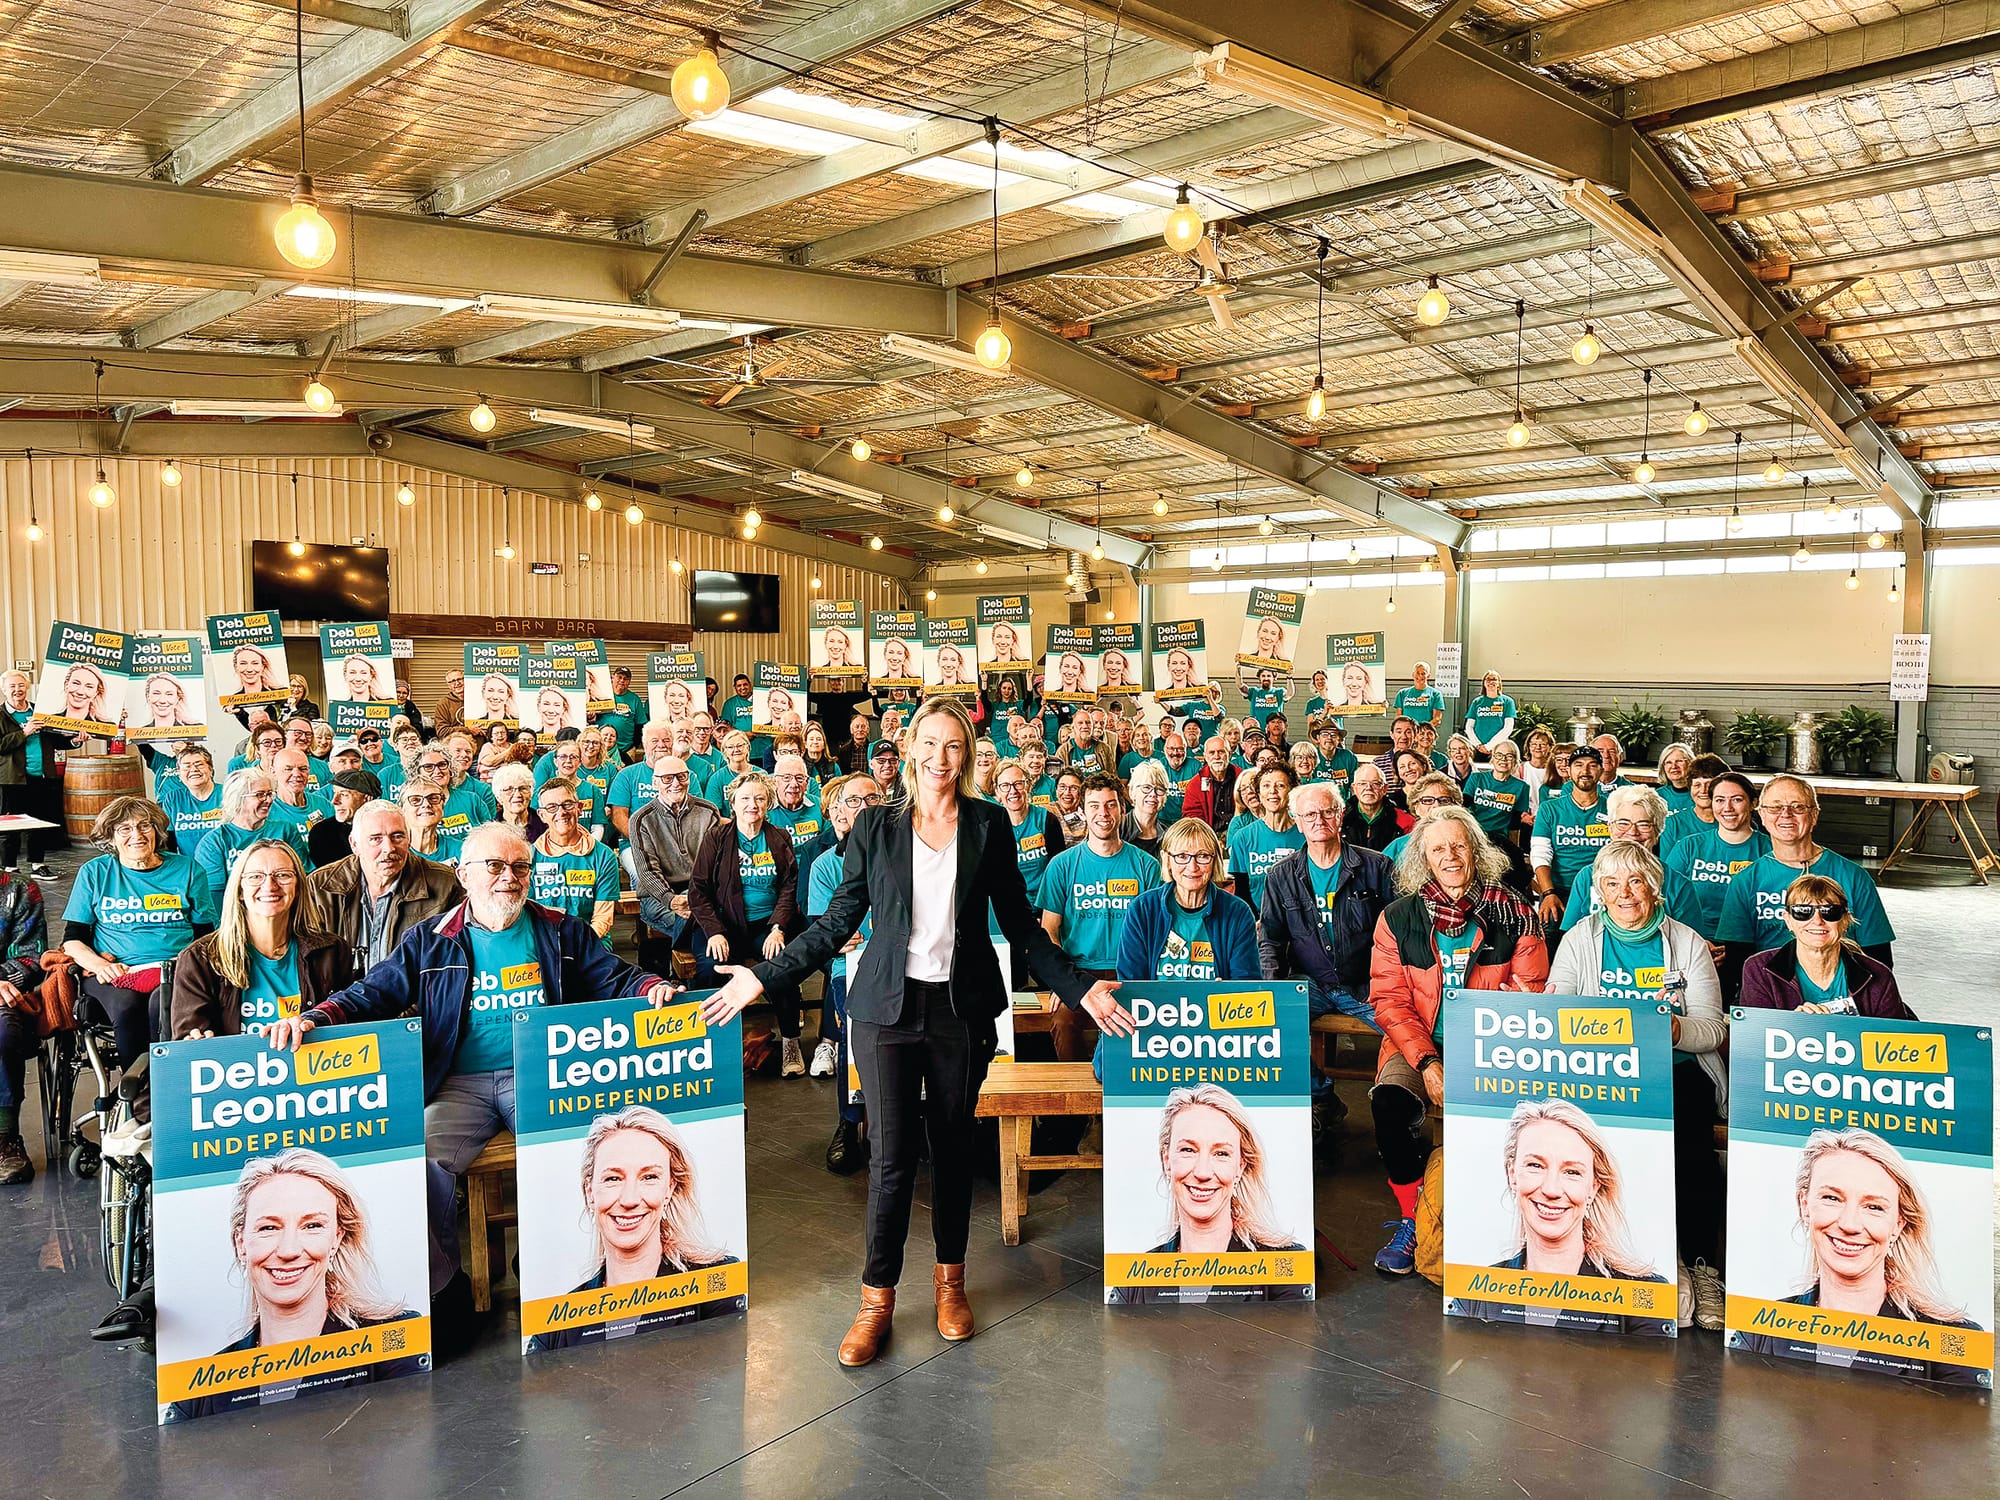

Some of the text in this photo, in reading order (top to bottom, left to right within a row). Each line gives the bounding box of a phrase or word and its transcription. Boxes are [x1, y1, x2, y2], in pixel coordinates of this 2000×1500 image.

[1257, 590, 1277, 601] Deb
[816, 603, 836, 612] Deb
[983, 600, 1003, 609] Deb
[983, 606, 1023, 616] Leonard
[1255, 599, 1296, 613] Leonard
[816, 611, 856, 620] Leonard
[876, 614, 896, 623] Deb
[216, 618, 244, 630] Deb
[495, 620, 596, 634] BARN BARR
[876, 622, 916, 631] Leonard
[928, 621, 948, 631] Deb
[1100, 627, 1115, 635] eb
[1158, 626, 1178, 635] Deb
[62, 627, 94, 643] Deb
[218, 625, 273, 639] Leonard
[328, 627, 355, 638] Deb
[929, 629, 968, 638] Leonard
[1054, 627, 1074, 637] Deb
[1100, 634, 1134, 643] eonard
[1158, 632, 1198, 643] Leonard
[219, 636, 274, 646] INDEPENDENT
[329, 635, 382, 648] Leonard
[552, 643, 575, 652] Deb
[1053, 636, 1093, 646] Leonard
[1334, 638, 1354, 646] Deb
[59, 638, 123, 660] Leonard
[331, 647, 383, 655] INDEPENDENT
[472, 647, 496, 657] Deb
[1334, 645, 1376, 655] Leonard
[57, 651, 121, 668] INDEPENDENT
[528, 659, 552, 668] Deb
[654, 656, 675, 665] Deb
[528, 669, 577, 679] Leonard
[654, 664, 697, 673] Leonard
[761, 665, 780, 674] Deb
[761, 672, 800, 682] Leonard
[338, 706, 364, 716] Deb
[176, 811, 202, 822] Deb
[1556, 825, 1584, 837] Deb
[1694, 859, 1727, 873] Deb
[569, 872, 585, 882] Vote
[1692, 870, 1732, 884] Leon
[1074, 884, 1106, 897] Deb
[1111, 884, 1129, 893] Vote
[101, 896, 143, 912] Deb
[150, 896, 171, 908] Vote
[1074, 897, 1130, 910] Leonar
[102, 908, 184, 925] Leonard
[471, 971, 499, 992] eb
[508, 968, 533, 986] Vote
[1601, 968, 1632, 986] eb
[240, 997, 275, 1018] eb
[1131, 997, 1204, 1027] Deb
[1218, 1000, 1267, 1023] Vote 1
[646, 1011, 698, 1040] Vote 1
[1474, 1007, 1554, 1040] Deb
[1569, 1016, 1624, 1037] Vote 1
[547, 1017, 630, 1057] Deb
[1131, 1028, 1281, 1059] Leonard
[1764, 1027, 1856, 1066] Deb
[1874, 1040, 1937, 1065] Vote 1
[308, 1044, 370, 1076] Vote 1
[548, 1038, 713, 1090] Leonard
[1474, 1038, 1640, 1079] Leonard
[190, 1051, 289, 1094] Deb
[1131, 1067, 1283, 1082] INDEPENDENT
[1475, 1076, 1641, 1103] INDEPENDENT
[1764, 1061, 1956, 1111] Leonard
[191, 1074, 388, 1132] Leonard
[549, 1078, 715, 1115] INDEPENDENT
[1764, 1101, 1956, 1137] INDEPENDENT
[192, 1117, 390, 1159] INDEPENDENT
[1126, 1257, 1268, 1280] MoreForMonash
[1467, 1273, 1624, 1305] MoreForMonash
[547, 1277, 700, 1325] MoreForMonash
[1752, 1307, 1931, 1350] MoreForMonash
[188, 1334, 373, 1391] MoreForMonash
